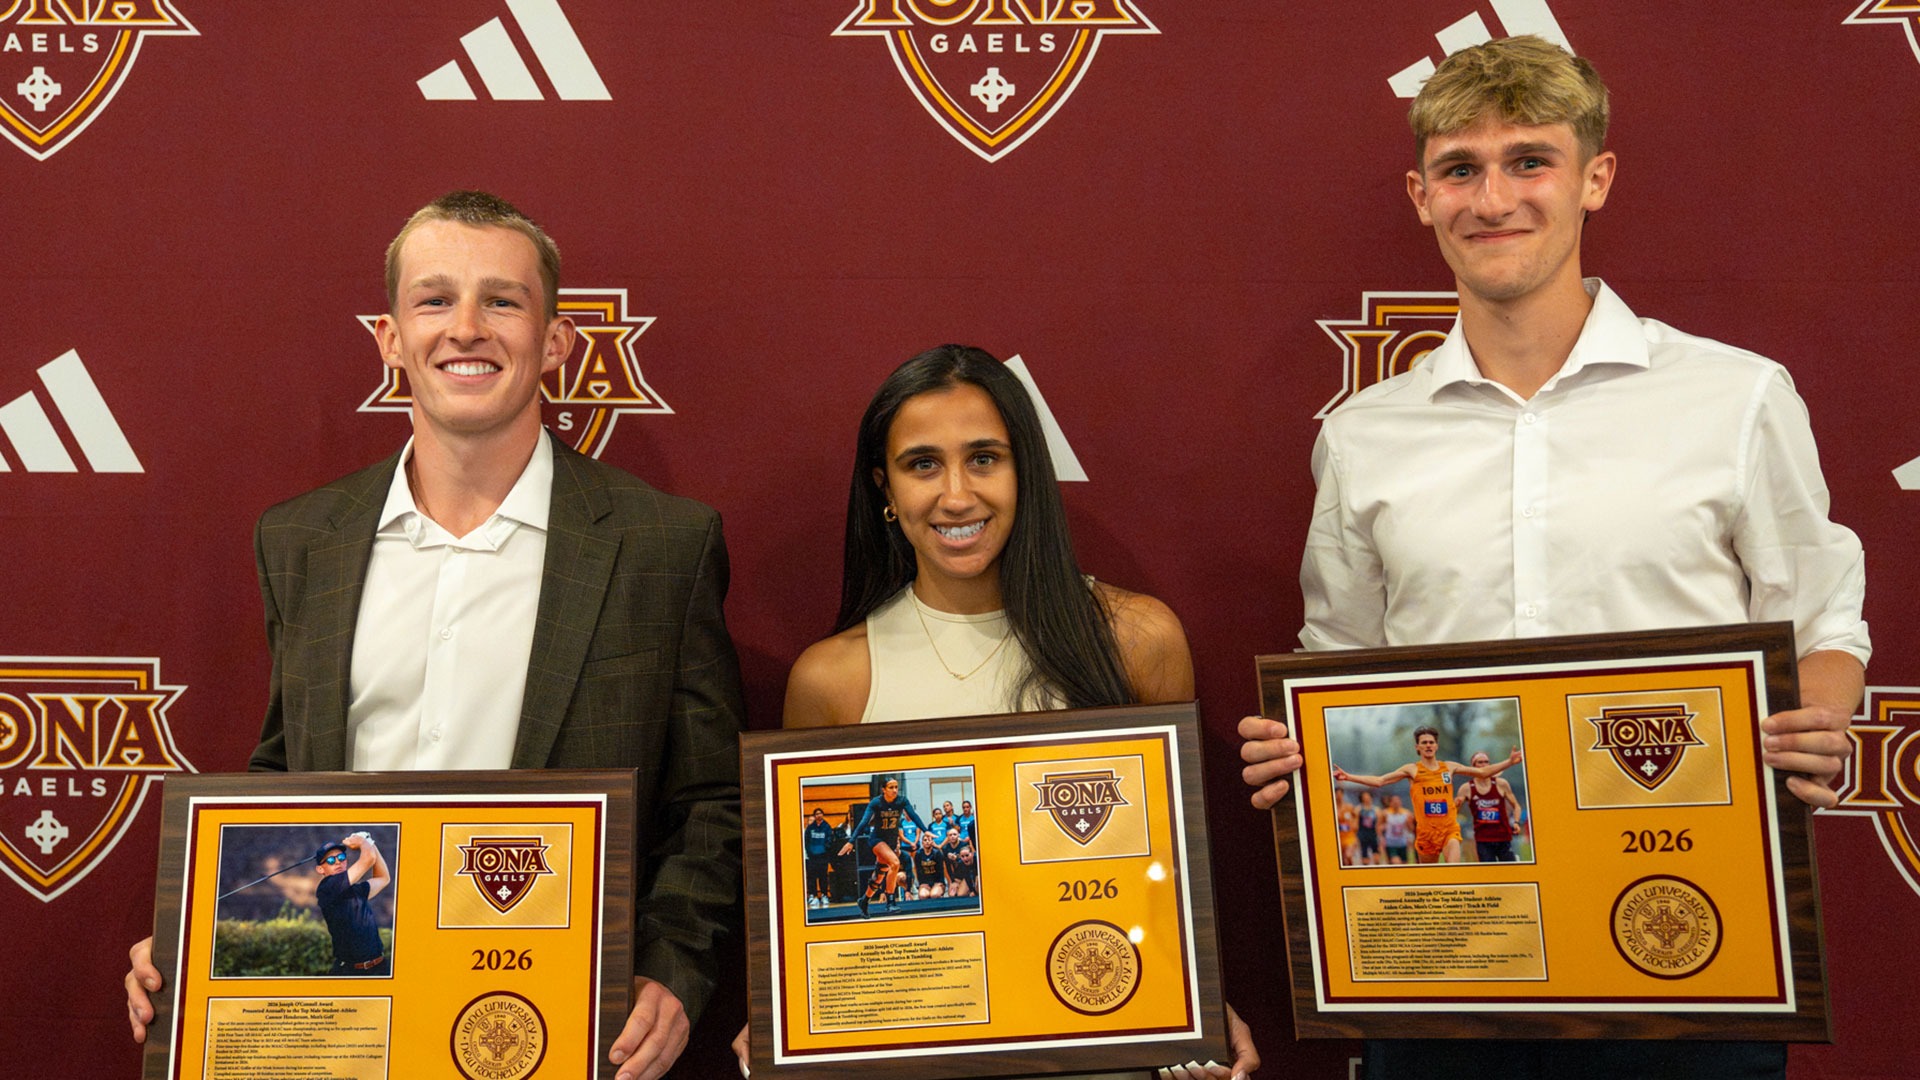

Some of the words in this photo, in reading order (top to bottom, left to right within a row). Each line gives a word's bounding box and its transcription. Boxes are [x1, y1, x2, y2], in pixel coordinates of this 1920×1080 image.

[4, 33, 99, 52] AELS
[930, 33, 1056, 53] GAELS
[1592, 715, 1701, 748] IONA
[1623, 747, 1672, 757] GAELS
[0, 777, 107, 797] AELS
[1038, 779, 1126, 809] IONA
[1422, 785, 1449, 796] IONA
[1061, 807, 1101, 816] GAELS
[1430, 803, 1442, 814] 56
[1620, 828, 1693, 853] 2026
[462, 847, 549, 873] IONA
[484, 874, 525, 882] GAELS
[1057, 878, 1119, 902] 2026
[471, 948, 533, 971] 2026
